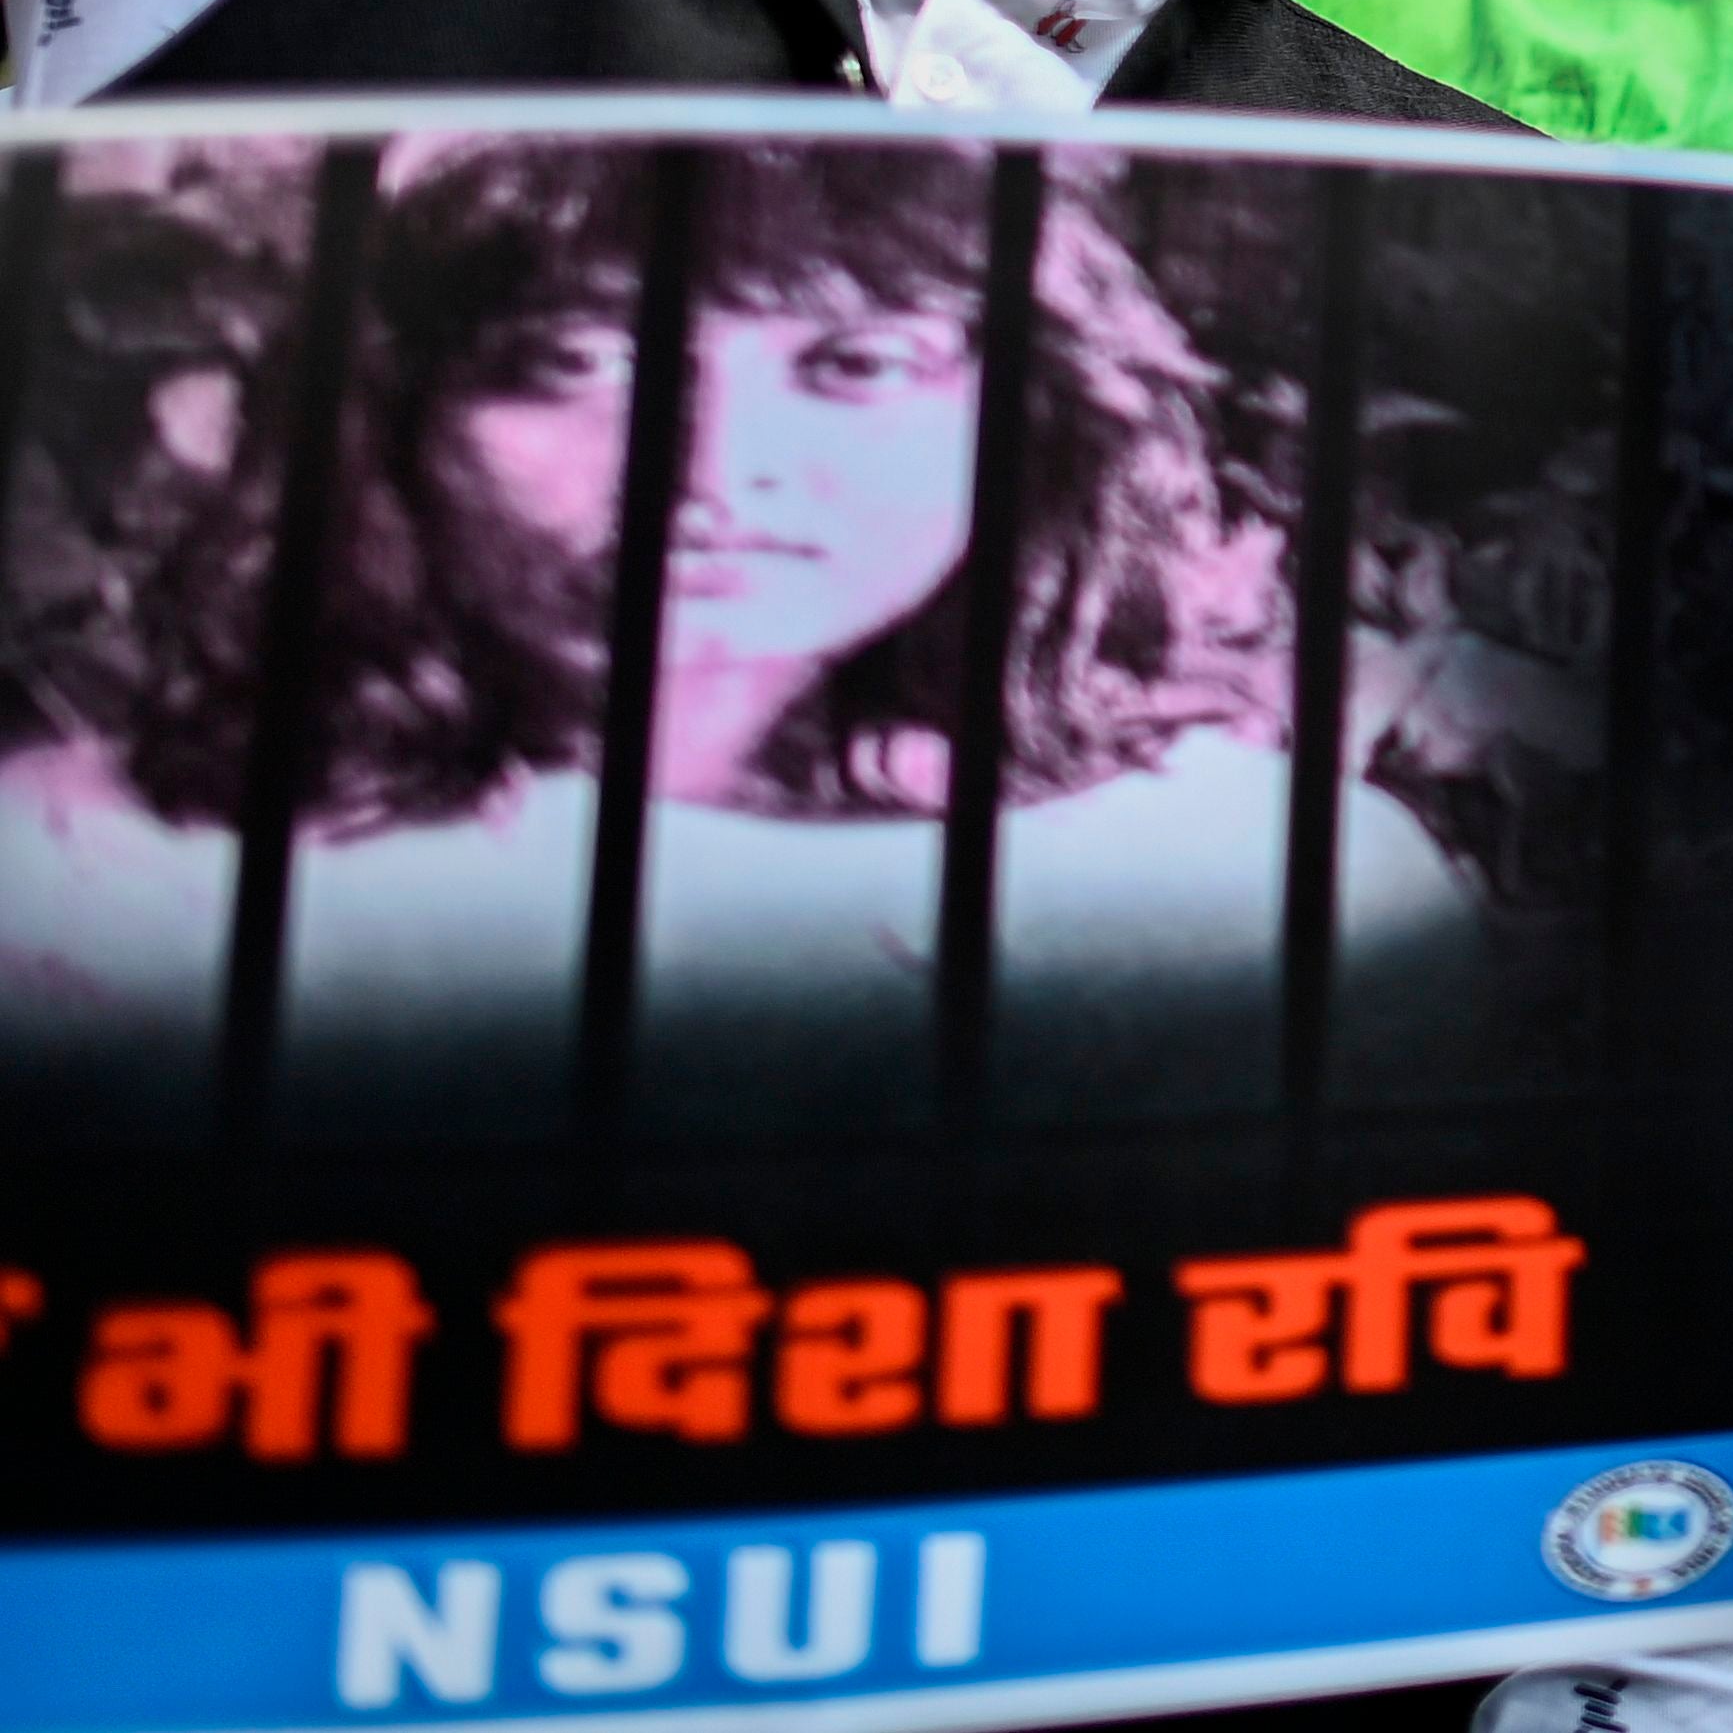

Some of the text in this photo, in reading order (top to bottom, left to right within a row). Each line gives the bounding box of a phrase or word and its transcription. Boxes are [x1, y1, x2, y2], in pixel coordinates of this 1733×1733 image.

[82, 1247, 434, 1459] भी
[494, 1238, 1124, 1446] दिशा
[1174, 1193, 1587, 1405] रवि
[336, 1530, 987, 1710] NSUI
